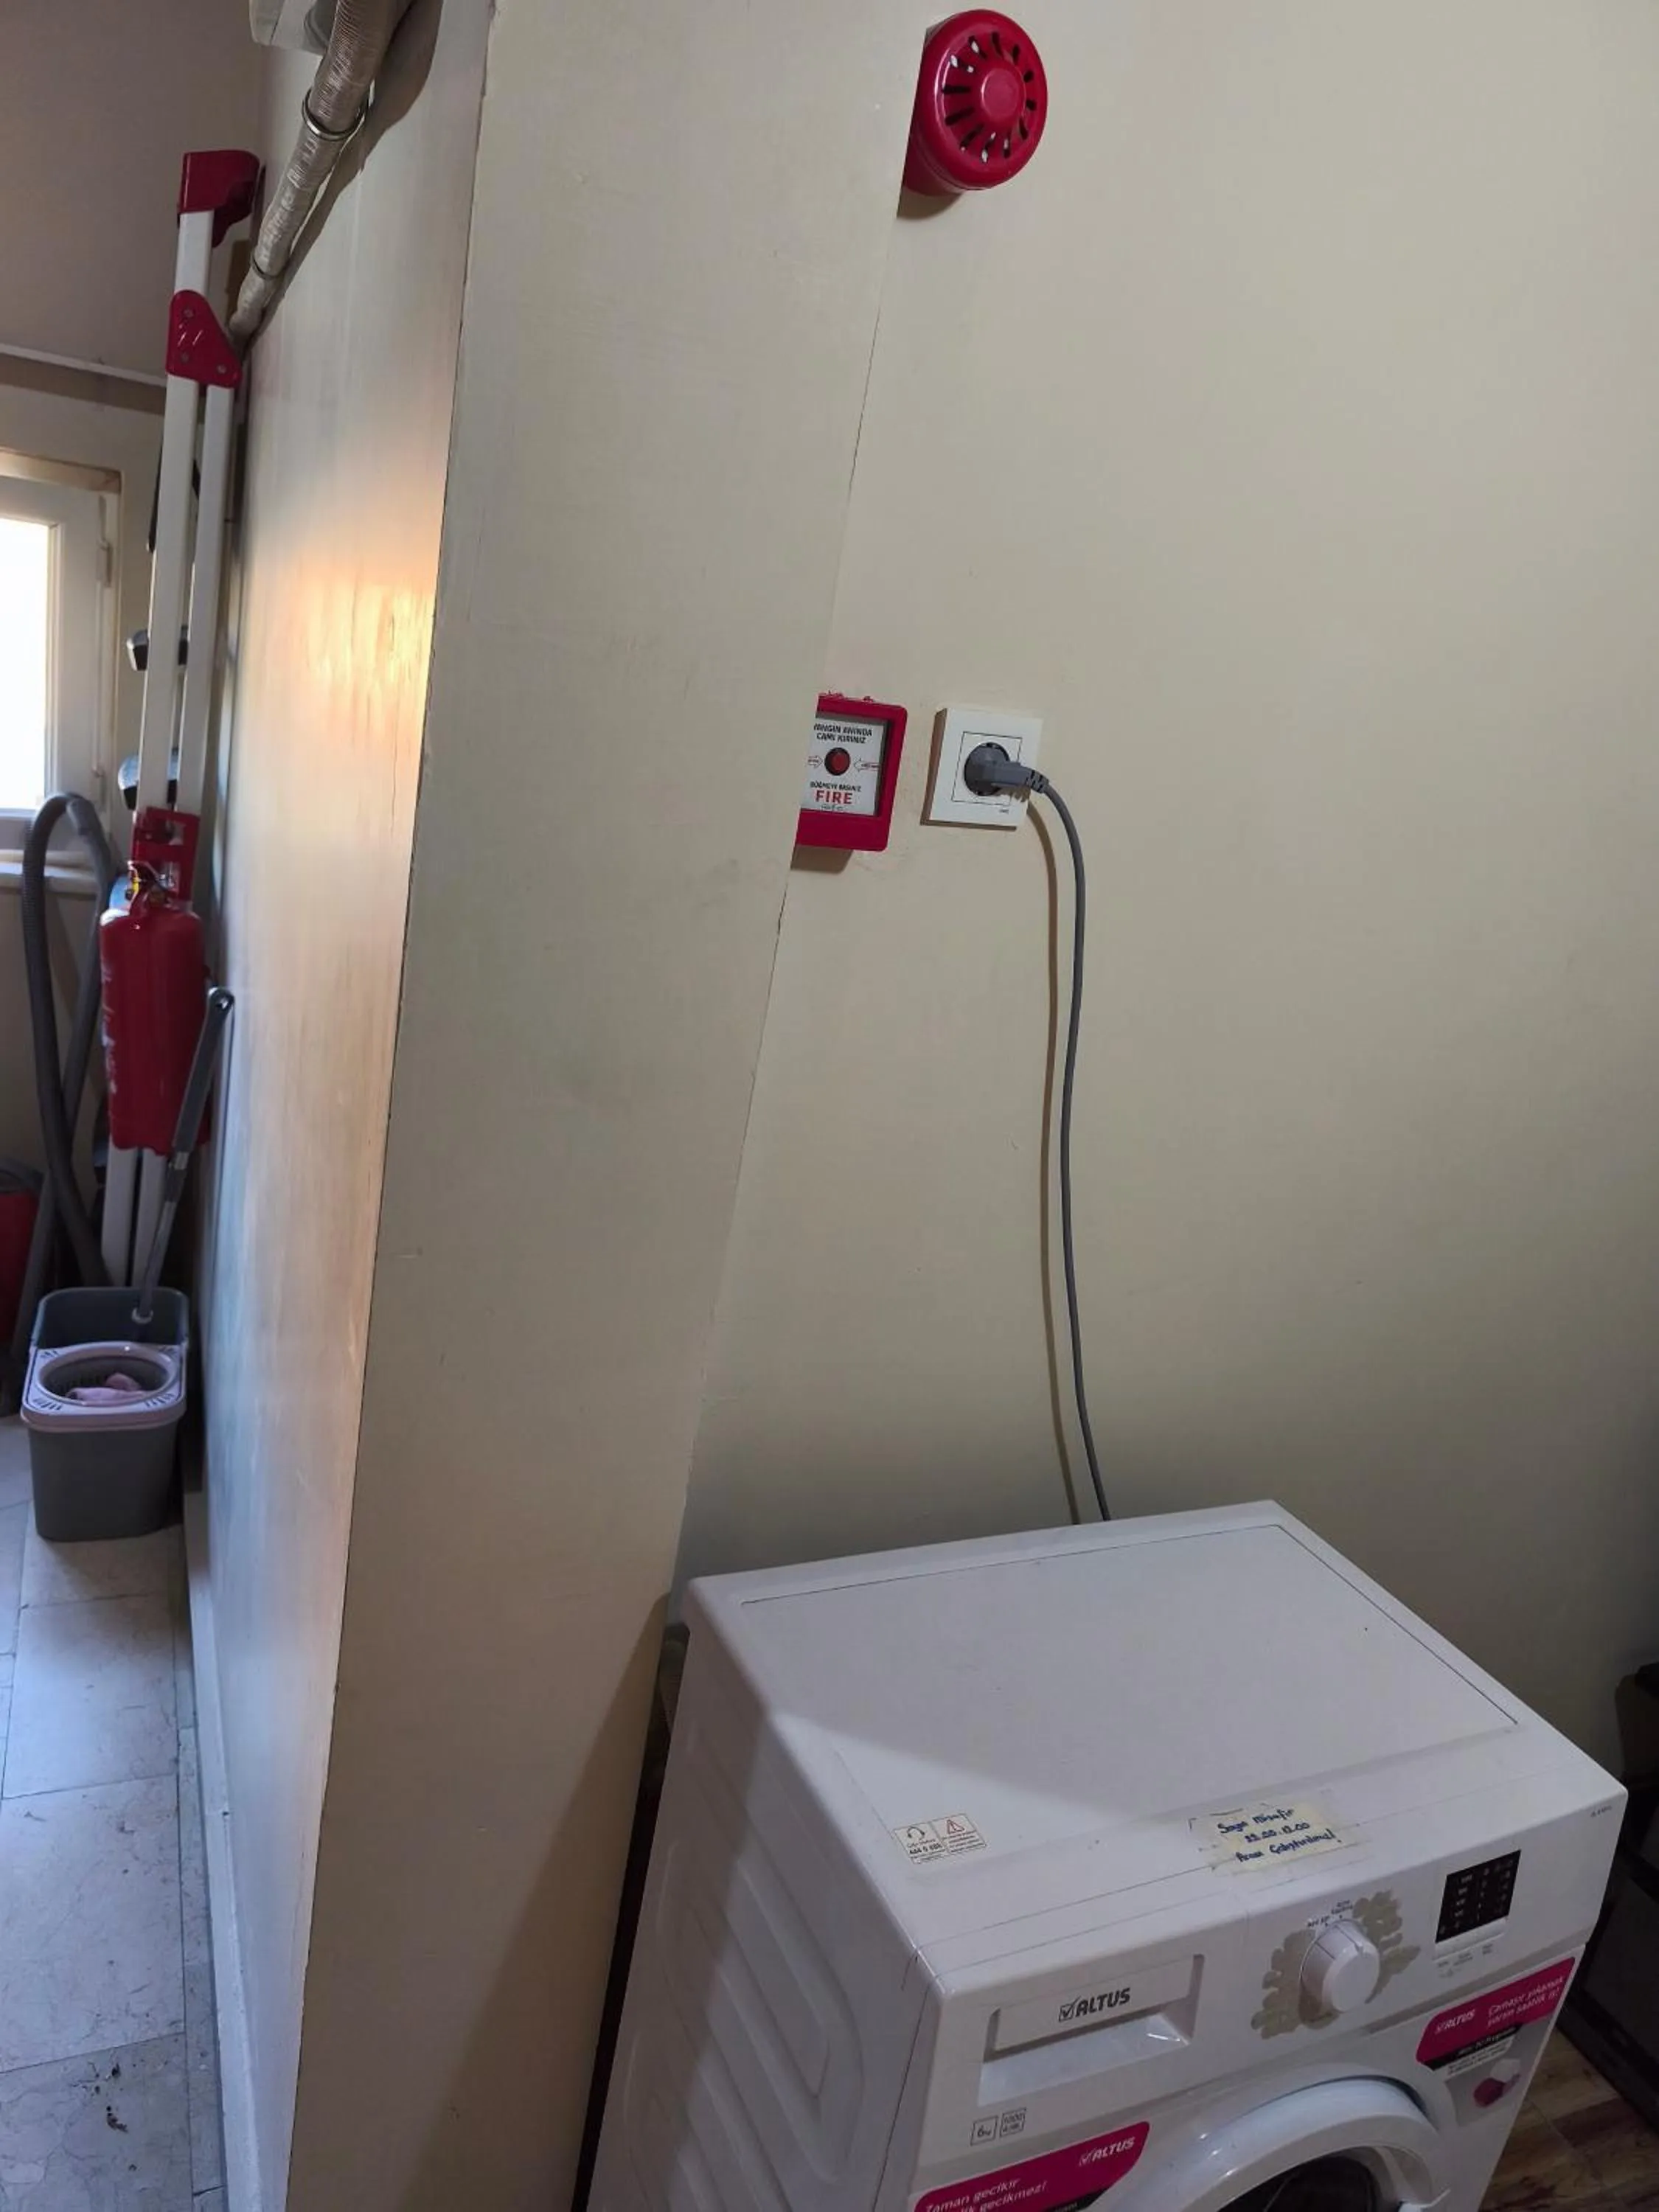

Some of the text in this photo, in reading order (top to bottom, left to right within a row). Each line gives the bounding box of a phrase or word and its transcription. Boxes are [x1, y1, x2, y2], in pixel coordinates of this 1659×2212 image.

[815, 790, 853, 804] FIRE
[1075, 1988, 1131, 2018] ALTUS
[1091, 2137, 1135, 2163] ALTUS
